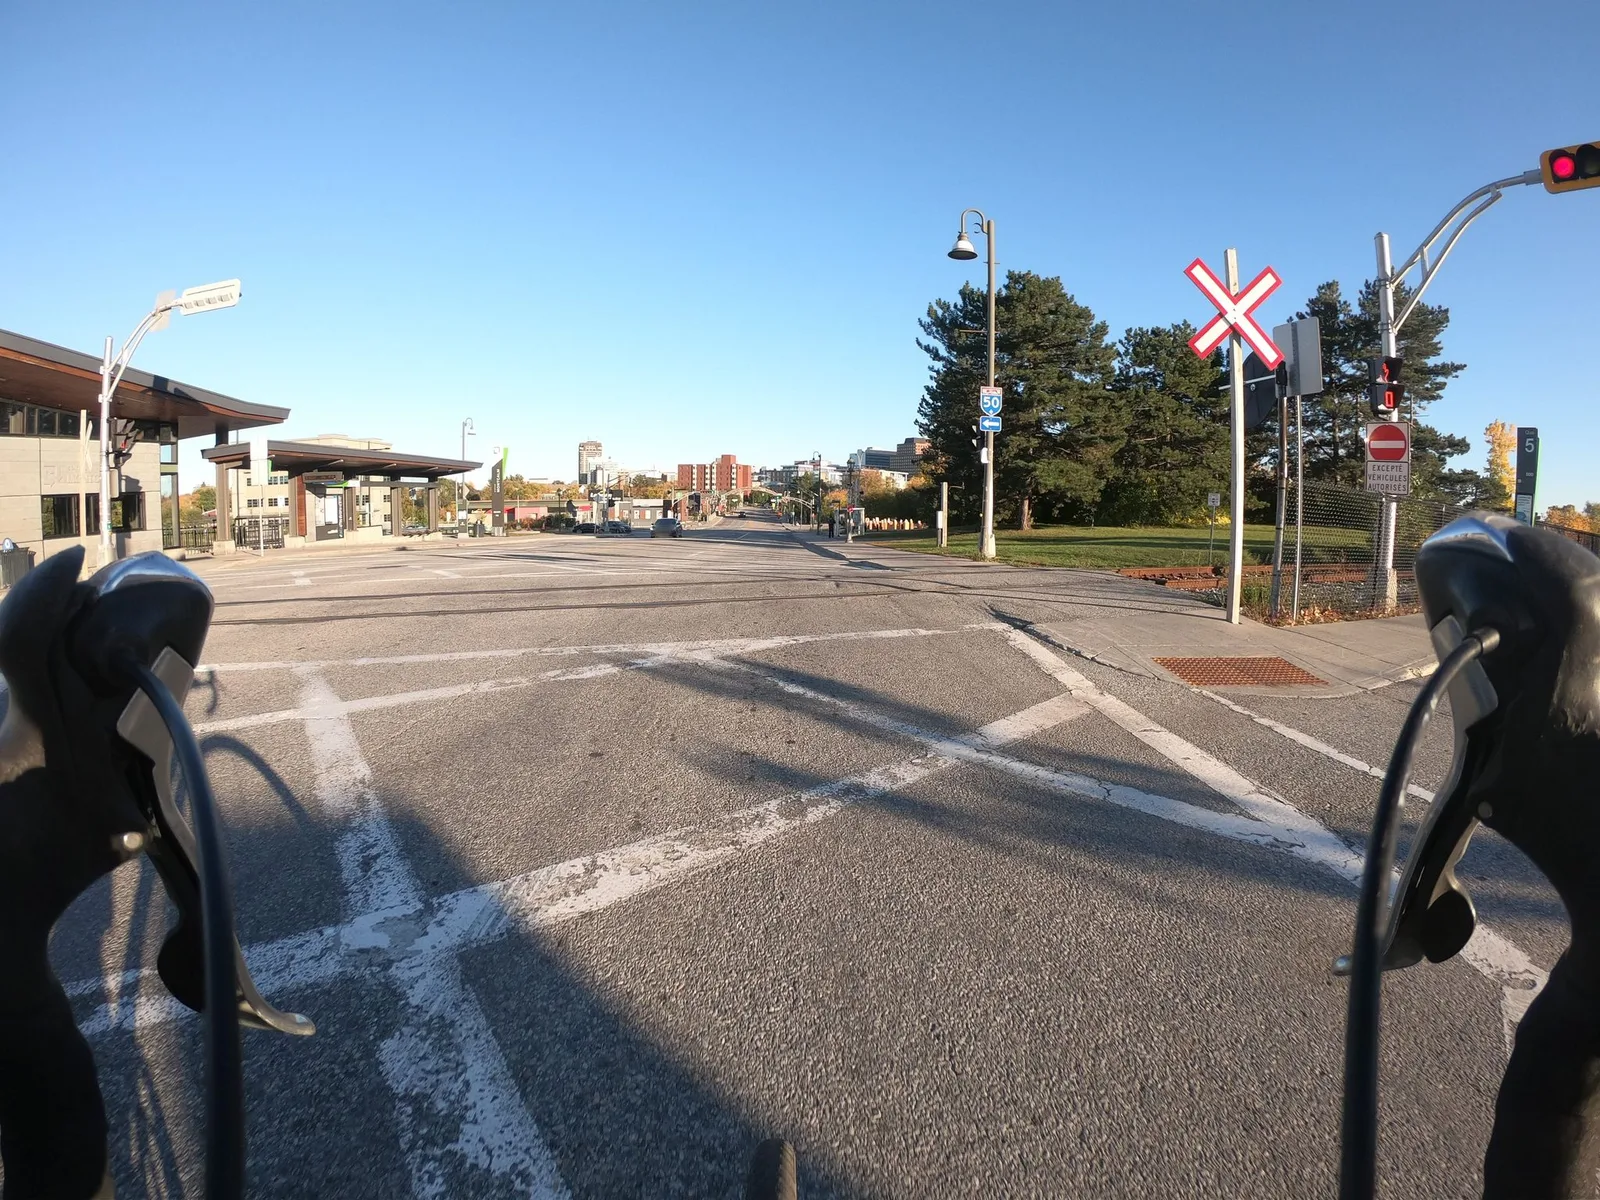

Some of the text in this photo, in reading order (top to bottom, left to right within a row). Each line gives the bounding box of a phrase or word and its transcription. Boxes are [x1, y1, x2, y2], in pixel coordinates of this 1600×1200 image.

[983, 397, 1000, 408] 50
[1525, 438, 1535, 453] 5
[1372, 464, 1403, 472] EXCEPTÉ
[1368, 472, 1407, 482] VÉHICULES
[1368, 482, 1407, 492] AUTORISÉS
